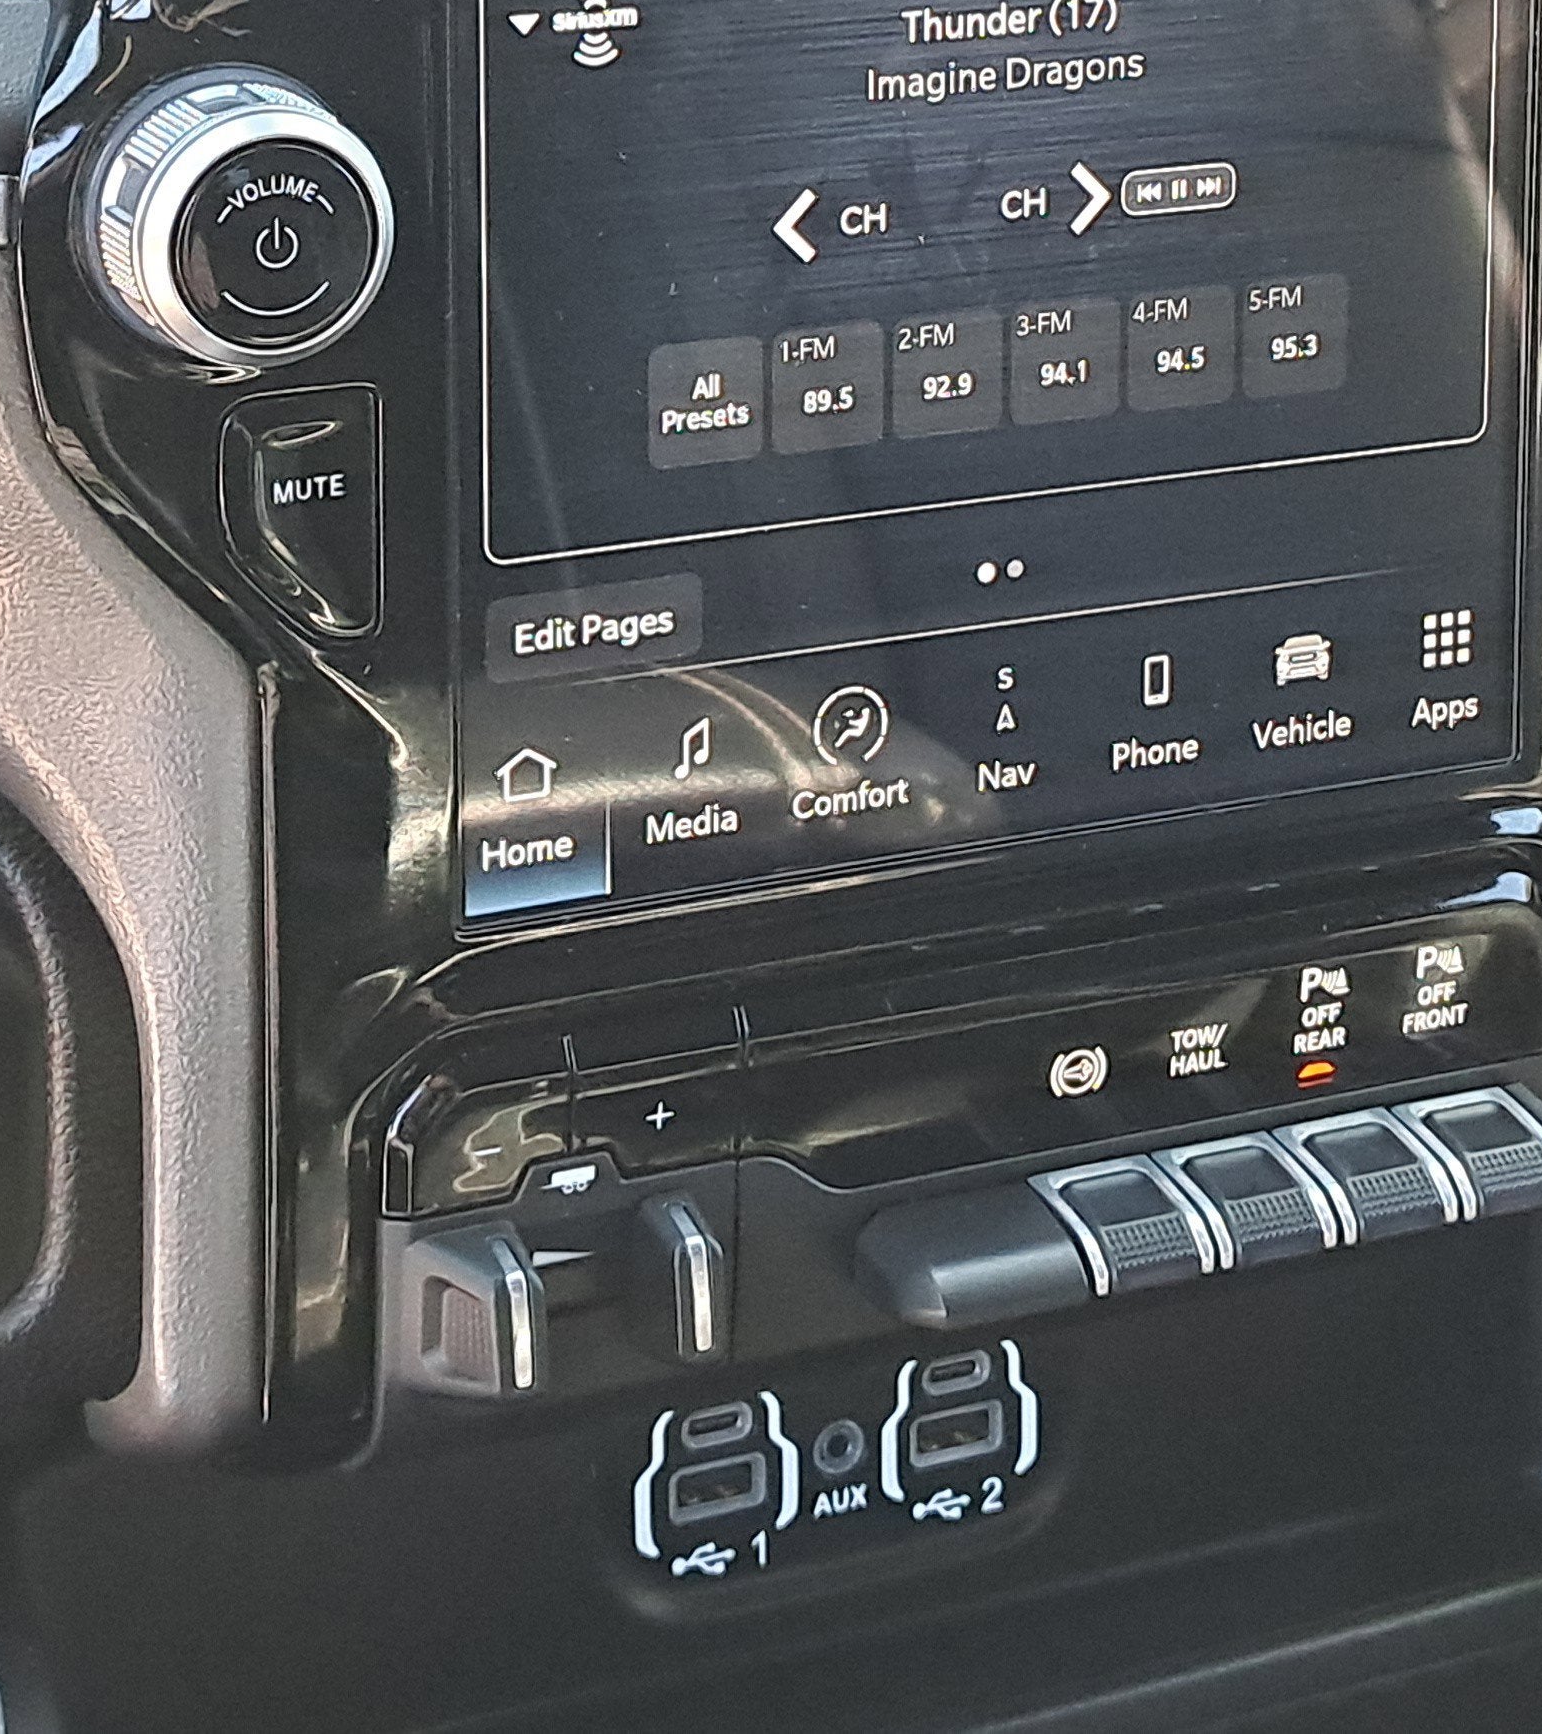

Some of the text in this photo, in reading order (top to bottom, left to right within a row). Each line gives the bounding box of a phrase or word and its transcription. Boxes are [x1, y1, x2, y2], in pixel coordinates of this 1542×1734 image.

[901, 2, 1042, 43] Thunder
[866, 52, 1144, 102] Imagine Dragons
[226, 172, 320, 210] VOLUME
[1000, 187, 1049, 219] CH
[840, 204, 889, 236] CH
[1132, 297, 1189, 324] 4-FM
[1248, 285, 1303, 312] 5-FM
[897, 322, 955, 351] 2-FM
[1015, 310, 1072, 338] 3-FM
[779, 335, 835, 363] 1-FM
[1156, 346, 1206, 373] 94.5
[1271, 333, 1319, 361] 95.3
[691, 372, 723, 400] All
[922, 372, 973, 401] 92.9
[1039, 359, 1090, 386] 94.1
[803, 386, 855, 415] 89.5
[660, 402, 751, 434] Presets
[272, 473, 346, 503] MUTE
[514, 609, 676, 656] Edit Pages
[1410, 696, 1480, 729] Apps
[1252, 709, 1352, 750] Vehicle
[1111, 736, 1199, 772] Phone
[977, 762, 1037, 792] Nav
[791, 778, 909, 821] Comfort
[645, 803, 739, 845] Media
[481, 833, 574, 872] Home
[1416, 980, 1456, 1007] OFF
[1301, 1004, 1343, 1029] OFF
[1402, 1001, 1469, 1034] FRONT
[1170, 1023, 1228, 1053] TOW/
[1294, 1027, 1347, 1055] REAR
[1169, 1047, 1228, 1078] HAUL
[813, 1482, 868, 1518] AUX
[980, 1475, 1005, 1514] 2
[751, 1529, 770, 1566] 1
